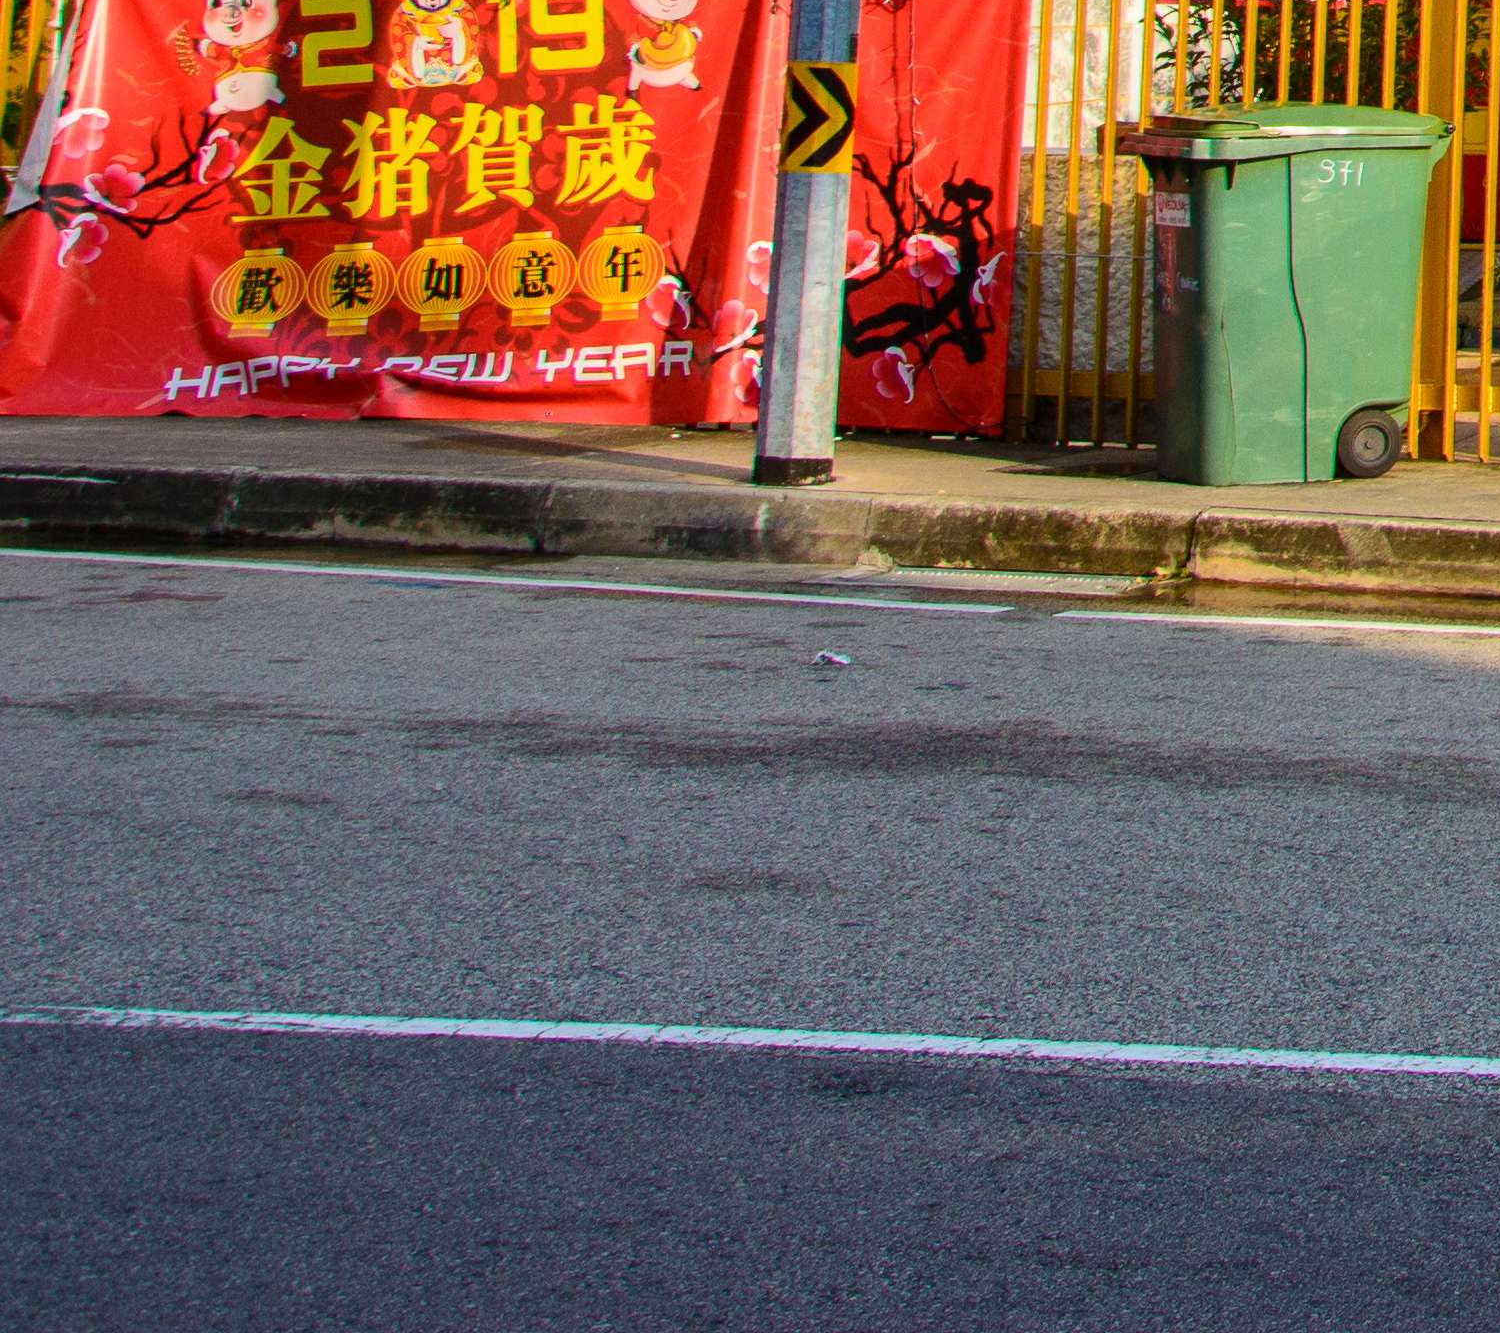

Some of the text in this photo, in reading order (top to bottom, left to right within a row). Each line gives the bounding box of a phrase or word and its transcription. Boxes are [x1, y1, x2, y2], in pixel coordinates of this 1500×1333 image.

[231, 94, 658, 223] 金猪賀歲
[236, 242, 648, 315] 歡樂如意年
[164, 355, 362, 402] HAPPY
[536, 339, 695, 383] YEAR
